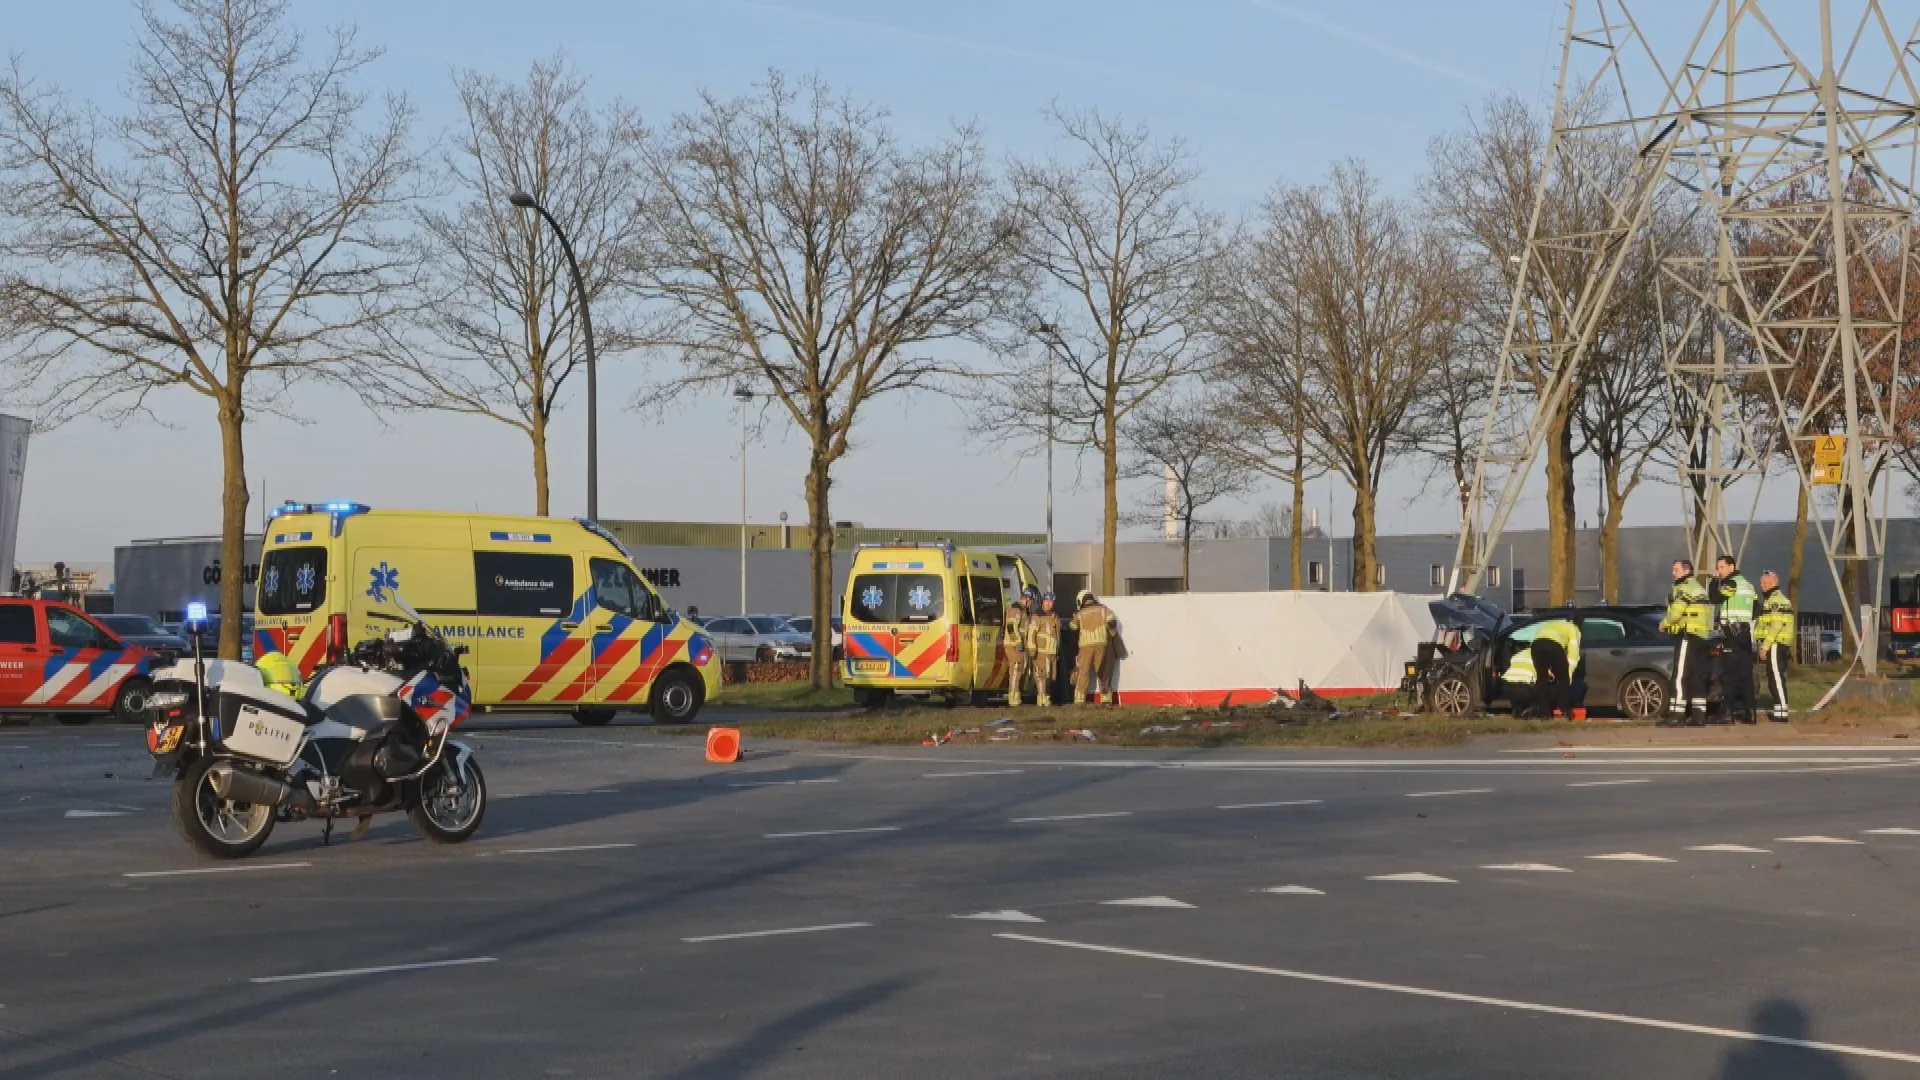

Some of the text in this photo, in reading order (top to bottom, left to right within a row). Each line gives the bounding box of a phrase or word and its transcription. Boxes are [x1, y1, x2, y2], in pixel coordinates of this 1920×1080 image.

[433, 625, 524, 639] AMBULANCE
[847, 624, 891, 632] AMBULANCE
[248, 720, 291, 742] POLITIE
